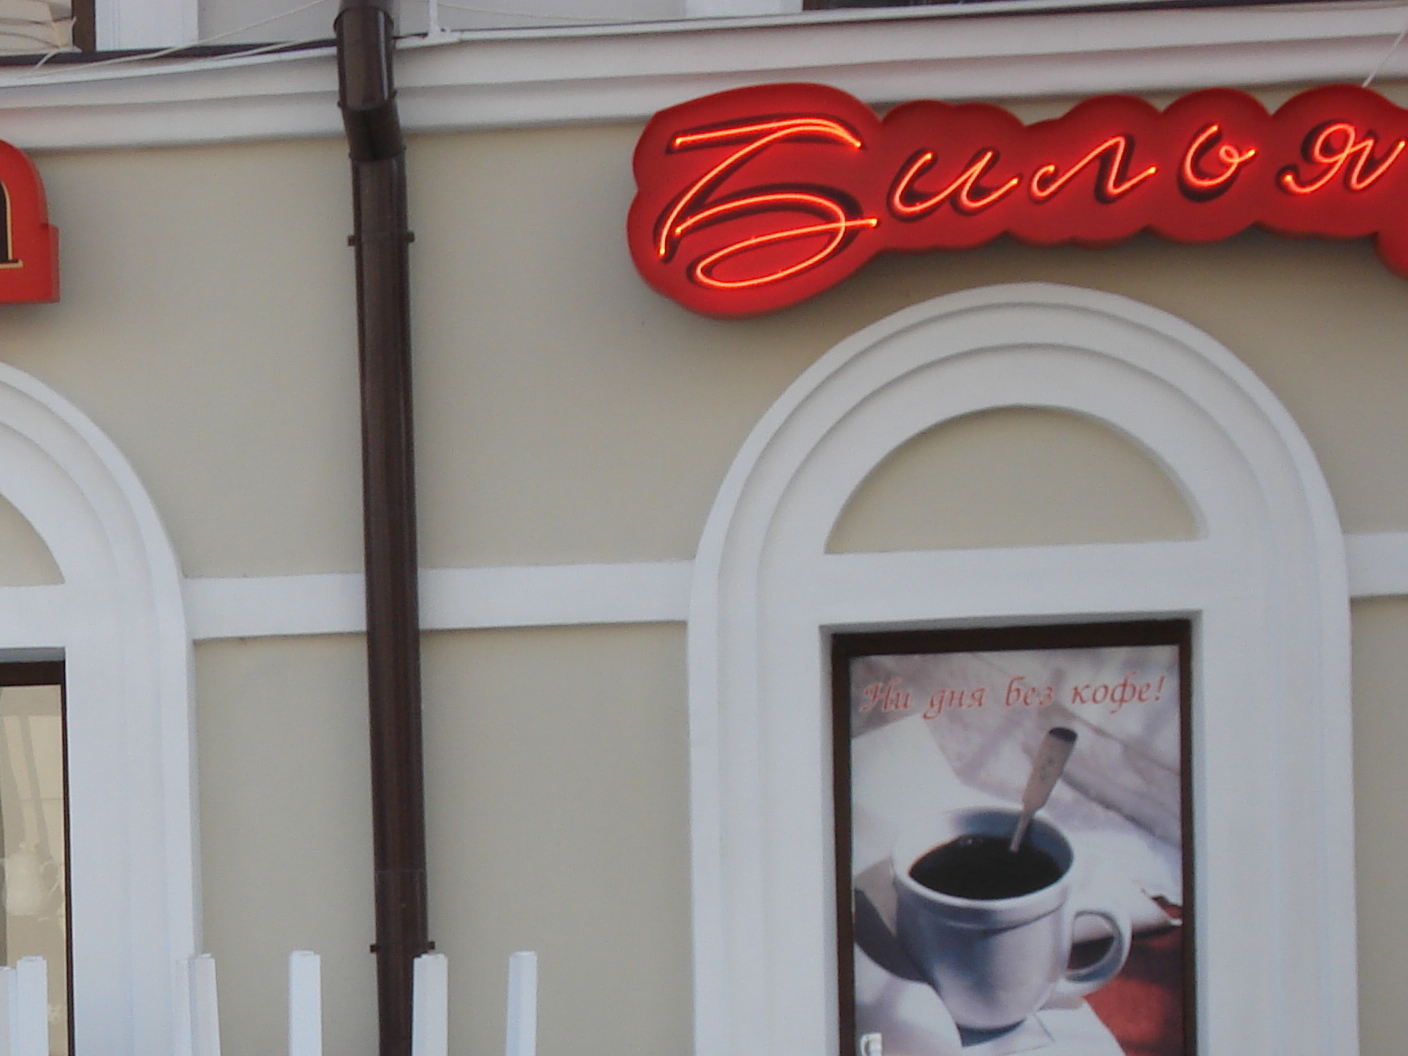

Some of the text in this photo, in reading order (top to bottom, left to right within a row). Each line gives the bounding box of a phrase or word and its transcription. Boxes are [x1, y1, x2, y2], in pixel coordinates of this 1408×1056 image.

[859, 669, 1167, 720] Ни дня без кофе!
